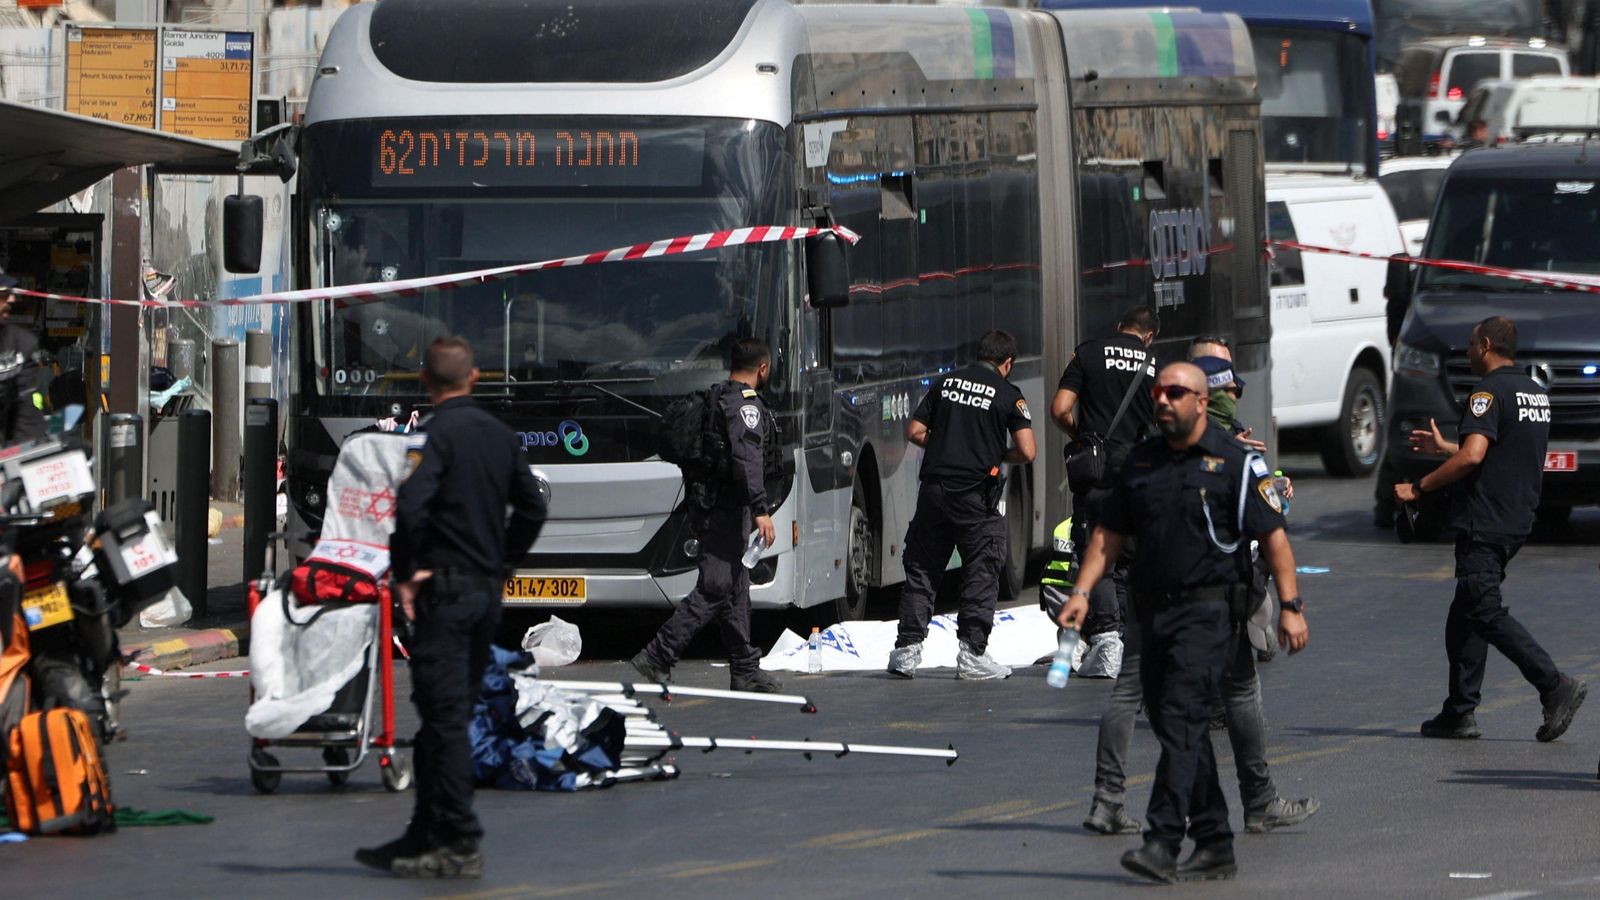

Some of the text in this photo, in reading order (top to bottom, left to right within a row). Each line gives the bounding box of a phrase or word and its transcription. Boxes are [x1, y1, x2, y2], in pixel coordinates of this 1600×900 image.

[164, 32, 187, 40] Ramot
[205, 51, 225, 60] 4009
[144, 60, 154, 69] 57
[102, 73, 122, 81] Scopus
[238, 103, 249, 111] 62
[231, 115, 249, 125] 506
[380, 130, 638, 175] תחנה מרכזית 62
[943, 378, 996, 398] משטרה
[941, 389, 992, 411] POLICE
[1518, 408, 1551, 423] POLIC
